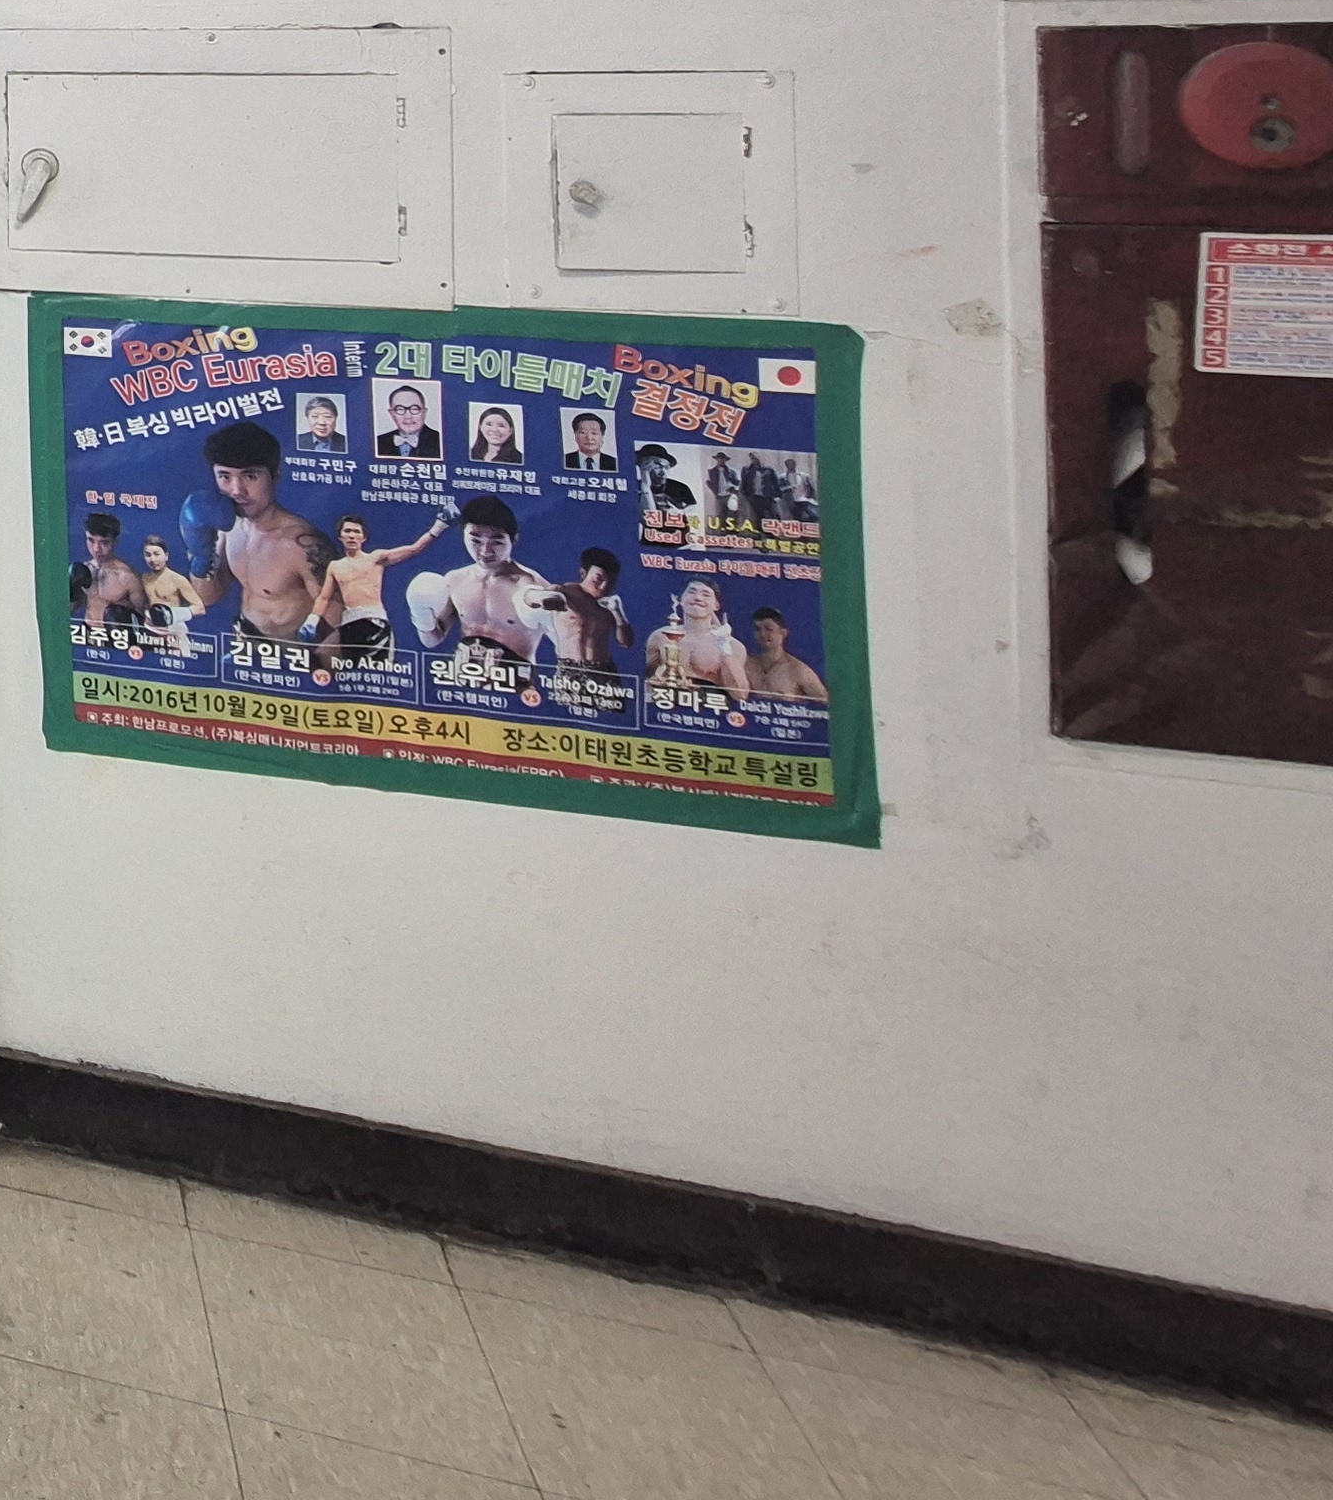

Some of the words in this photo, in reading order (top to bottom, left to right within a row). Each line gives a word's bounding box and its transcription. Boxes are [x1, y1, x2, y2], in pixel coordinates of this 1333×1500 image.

[1206, 307, 1226, 325] 3
[122, 326, 259, 367] Boxing
[1205, 329, 1224, 346] 4
[1205, 350, 1223, 366] 5
[110, 359, 198, 406] WBC
[201, 344, 338, 388] Eurasia
[342, 340, 367, 379] Interim
[374, 340, 432, 379] 2대
[442, 344, 623, 409] 타이틀매치
[613, 343, 761, 410] Boxing
[126, 411, 171, 439] 복싱
[171, 387, 284, 430] 빅라이벌전
[631, 378, 747, 445] 결정전
[318, 458, 358, 473] 구민구
[369, 464, 397, 476] 대회장
[399, 462, 448, 481] 손천일
[423, 480, 444, 493] 대표
[644, 527, 683, 545] Used
[707, 514, 760, 534] U.S.A.
[761, 518, 821, 539] 락밴드
[640, 553, 674, 569] WBC
[675, 555, 718, 574] Eurasia
[70, 623, 129, 651] 김주영
[230, 639, 311, 673] 김일권
[331, 656, 354, 671] Ryo
[357, 657, 413, 676] Akahori
[234, 669, 301, 689] (한국챔피언)
[429, 658, 517, 694] 원우민
[585, 679, 634, 699] Ozawa
[651, 687, 730, 716] 정마루
[739, 699, 772, 715] Daichi
[81, 676, 198, 713] 일시:2016년
[203, 691, 247, 719] 10월
[251, 700, 384, 736] 29일(토요일)
[388, 713, 472, 745] 오후4시
[502, 727, 739, 777] 장소:이태원초등학교
[742, 755, 818, 788] 특설링
